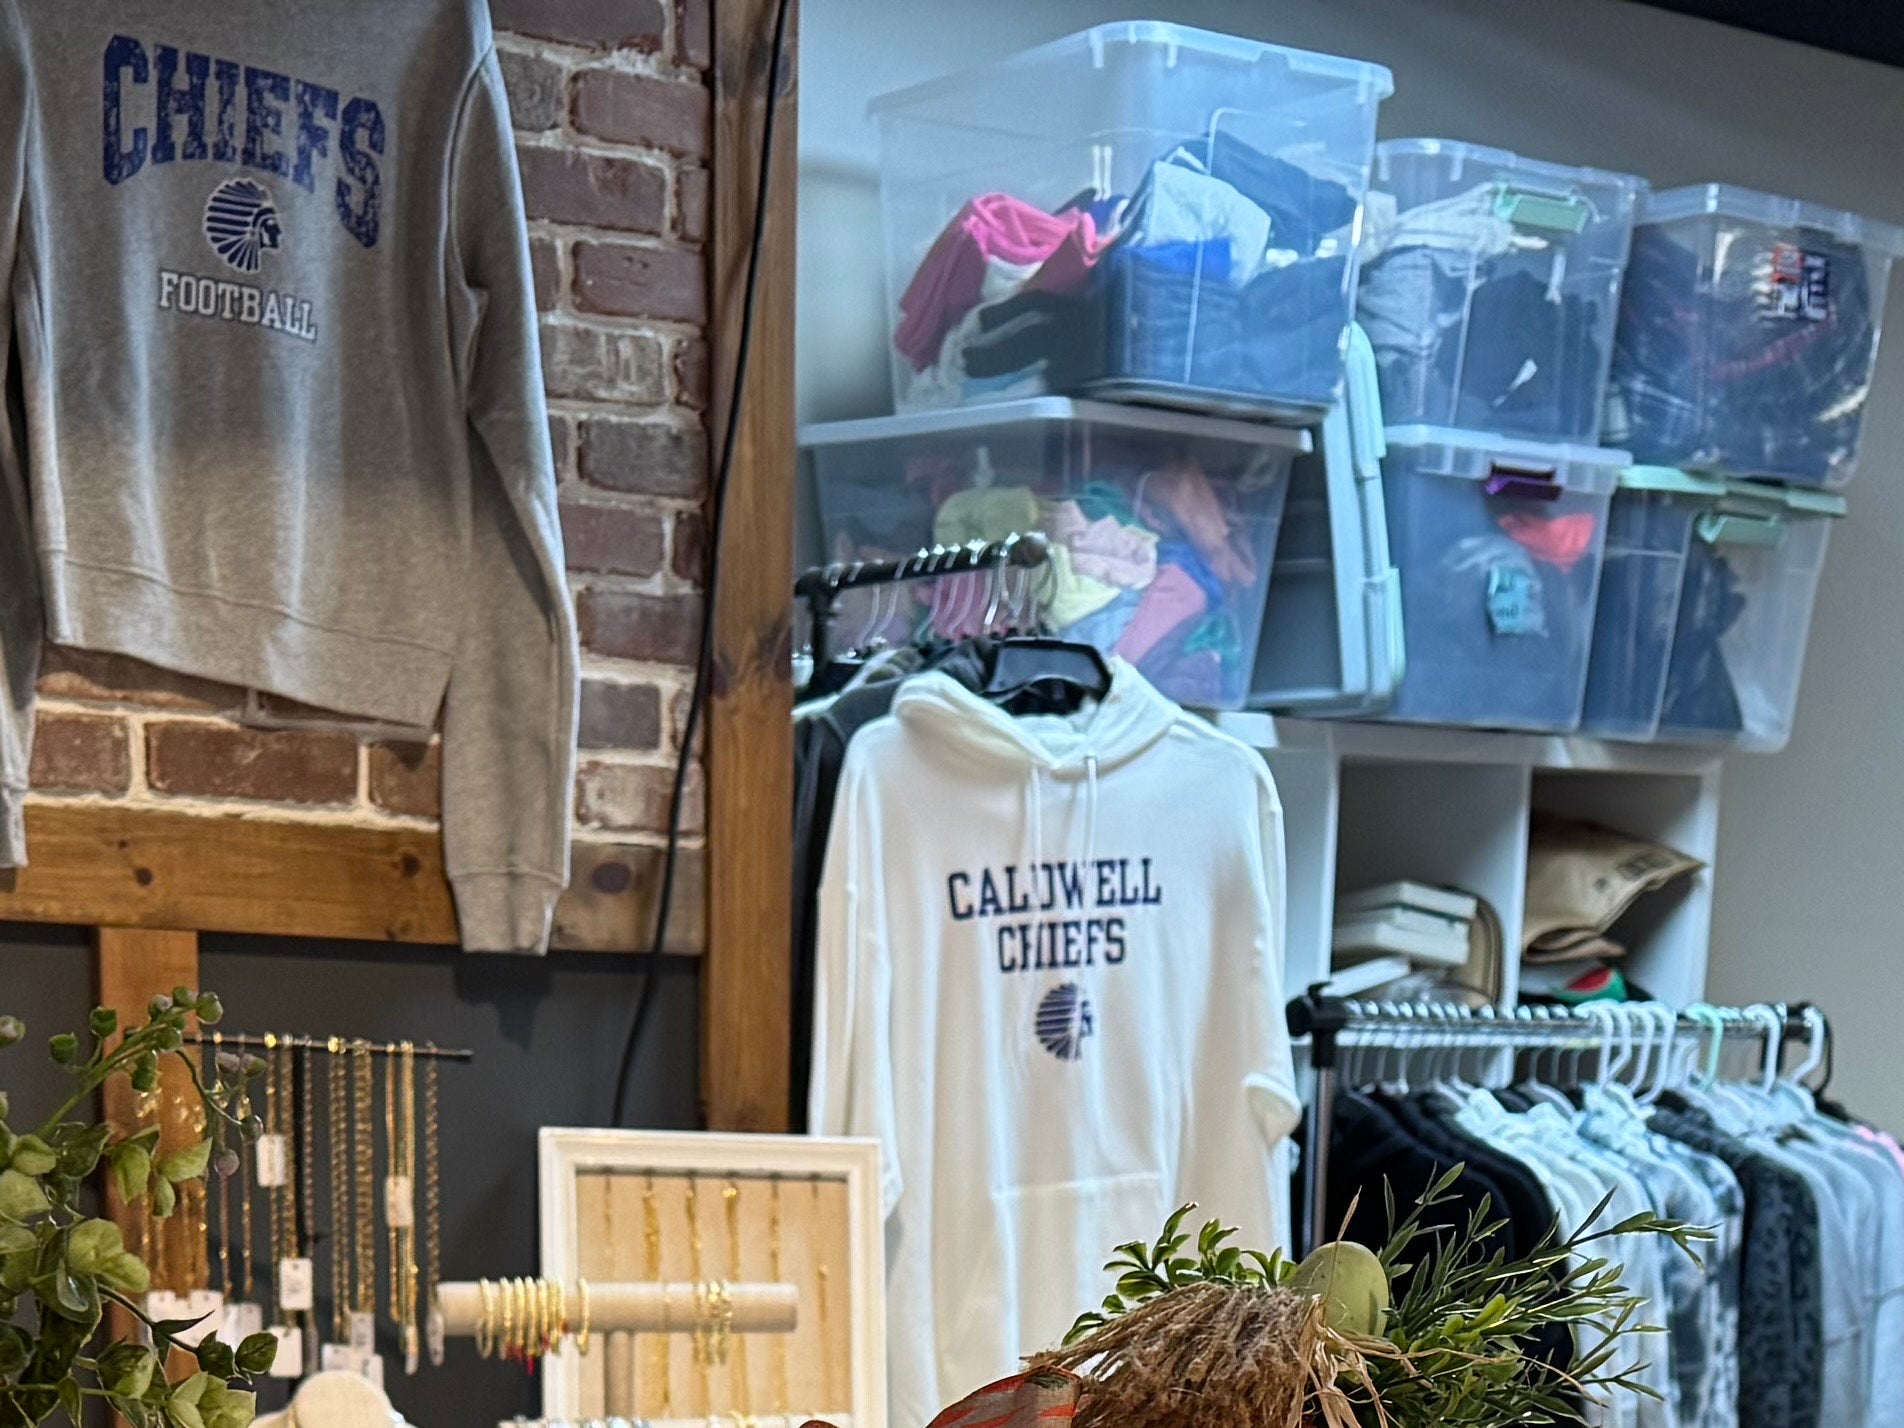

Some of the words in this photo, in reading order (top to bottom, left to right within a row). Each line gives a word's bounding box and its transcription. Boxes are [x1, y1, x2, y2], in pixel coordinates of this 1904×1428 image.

[102, 34, 386, 249] CHIEFS
[158, 269, 318, 343] FOOTBALL
[998, 917, 1126, 974] CHIEFS
